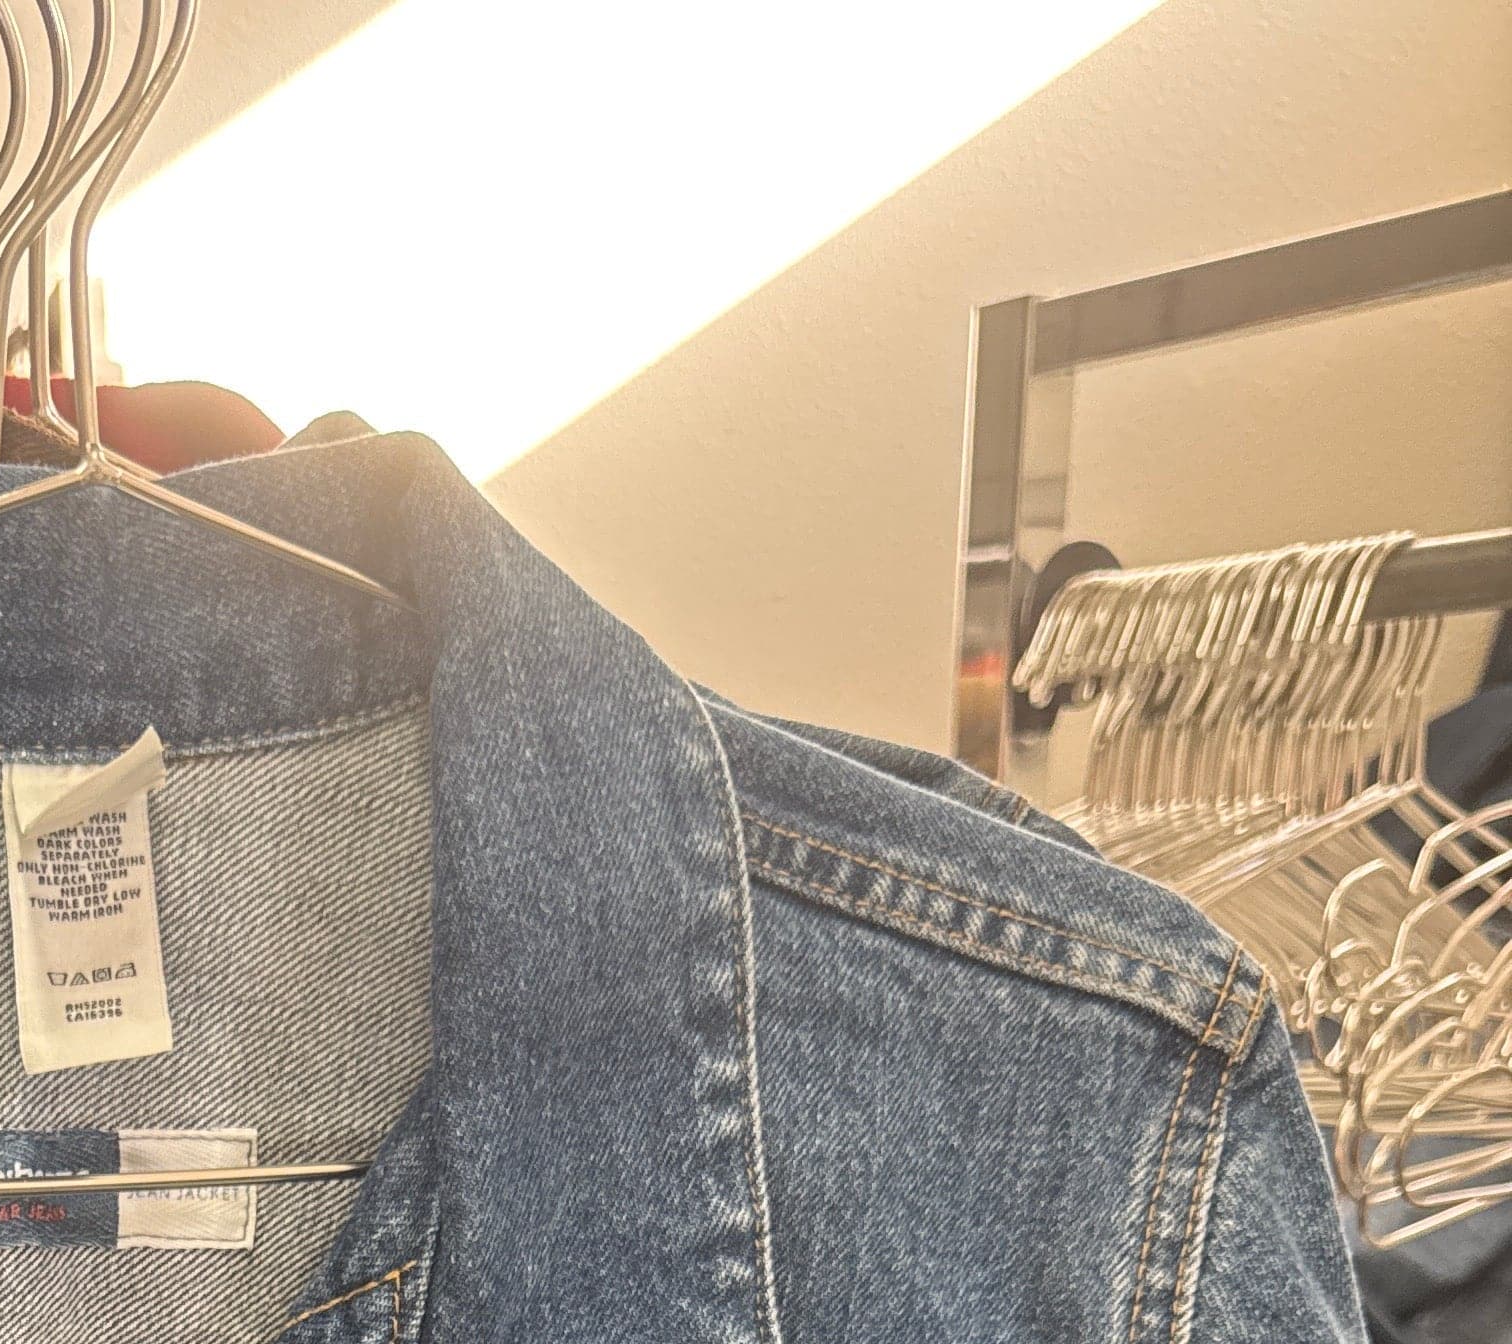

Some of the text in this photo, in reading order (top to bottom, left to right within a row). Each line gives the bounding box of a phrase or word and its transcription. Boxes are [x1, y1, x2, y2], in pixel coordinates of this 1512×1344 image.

[89, 812, 126, 824] WASH
[43, 825, 120, 838] ARM WASH
[37, 837, 122, 849] DARK COLORS
[41, 848, 119, 861] SEPARATELY
[17, 862, 48, 874] ONLY
[38, 869, 128, 886] BLEACH WHEN
[61, 883, 107, 897] NEEDED
[30, 888, 141, 910] TUMBLE DRY LOW
[49, 904, 123, 921] WARM IRON
[177, 1187, 239, 1200] JACKET
